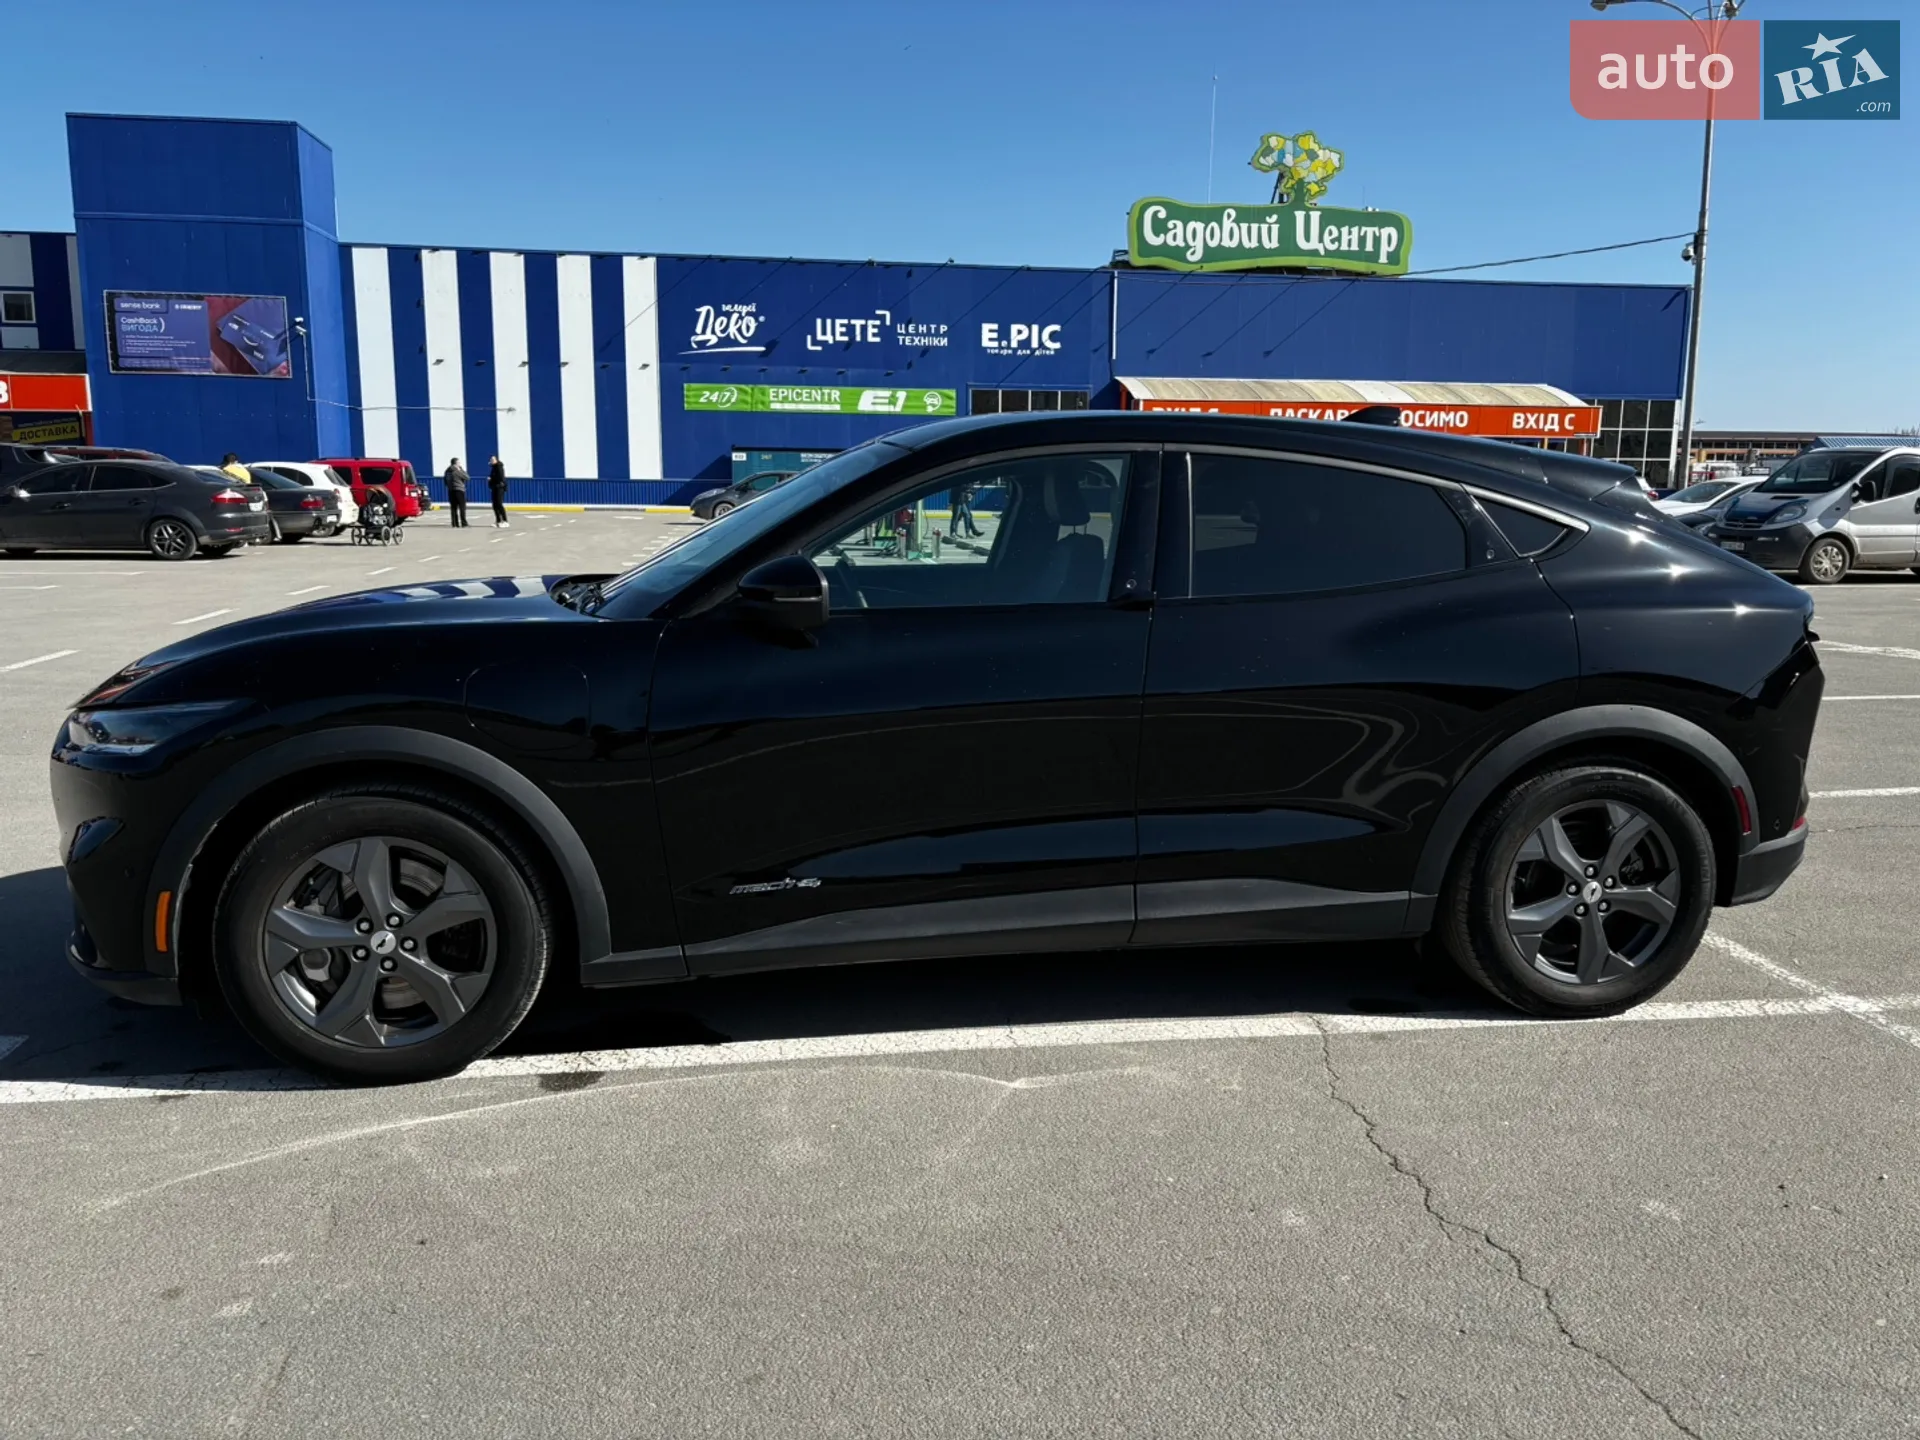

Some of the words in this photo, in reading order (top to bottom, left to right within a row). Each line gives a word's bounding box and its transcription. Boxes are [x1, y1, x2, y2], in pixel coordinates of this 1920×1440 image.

[1143, 205, 1281, 262] Садовий
[1294, 210, 1399, 264] Центр
[690, 305, 758, 348] Деко
[816, 318, 881, 344] ЦЕТЕ
[896, 323, 949, 334] ЦЕНТР
[981, 322, 1062, 349] E.PIC
[898, 336, 949, 346] ТЕХНІКИ
[769, 388, 841, 402] EPICENTR
[1512, 413, 1560, 432] ВХІД
[20, 425, 77, 441] ДОСТАВКА
